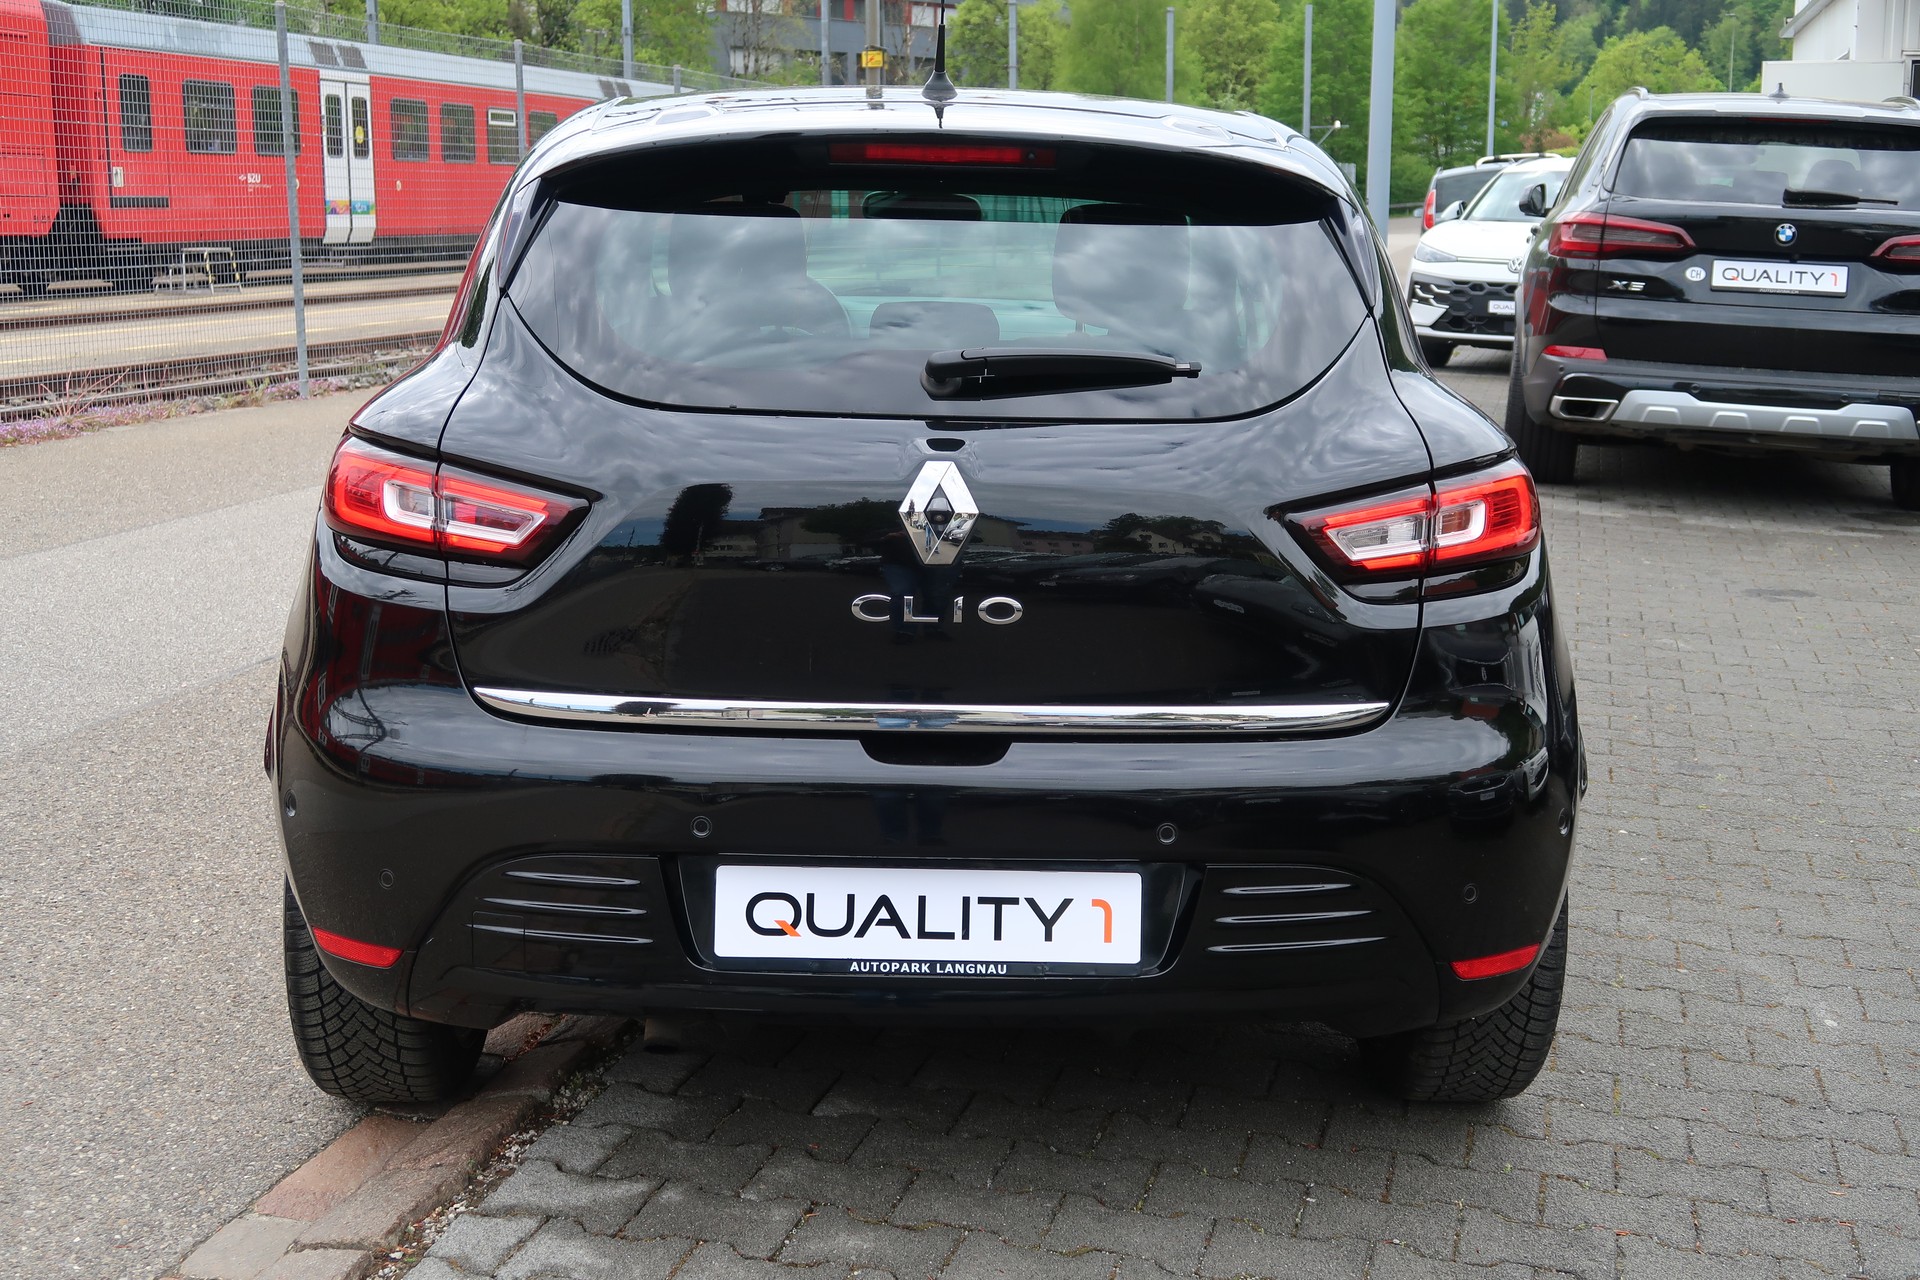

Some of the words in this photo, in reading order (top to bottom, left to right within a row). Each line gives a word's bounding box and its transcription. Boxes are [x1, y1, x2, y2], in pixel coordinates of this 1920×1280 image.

[1690, 269, 1702, 279] CH
[1722, 267, 1825, 285] QUALITY
[851, 594, 1023, 625] CLIO
[745, 892, 1075, 942] QUALITY
[1091, 898, 1113, 943] 1
[850, 961, 931, 974] AUTOPARK
[936, 963, 1008, 975] LANGNAU
